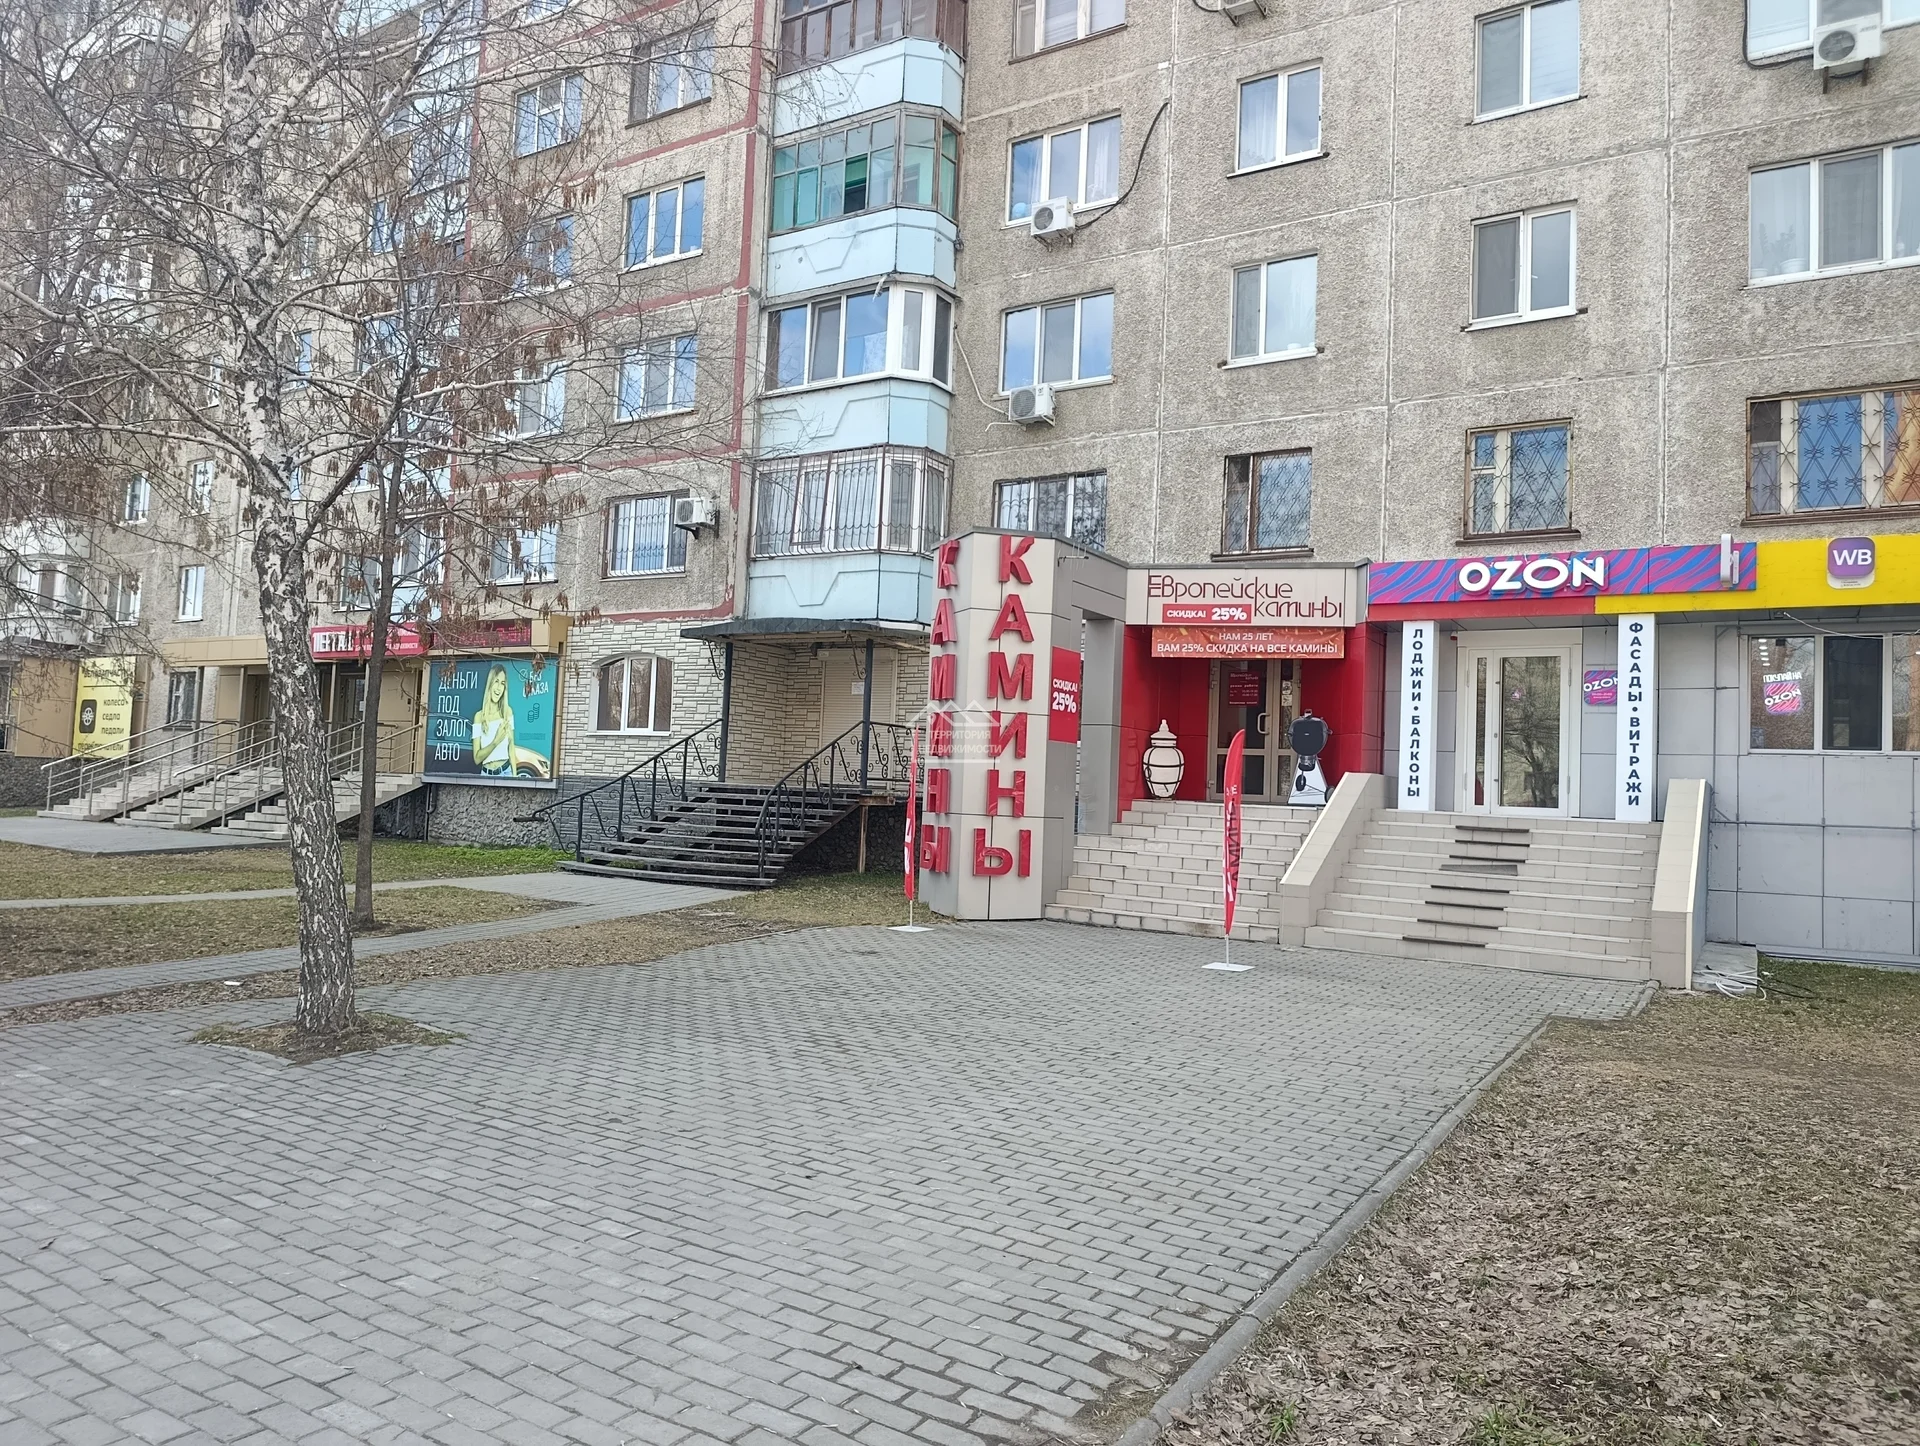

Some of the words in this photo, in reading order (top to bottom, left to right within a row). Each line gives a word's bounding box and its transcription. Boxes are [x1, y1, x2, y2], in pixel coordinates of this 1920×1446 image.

[1832, 549, 1873, 566] WB
[1458, 556, 1605, 592] OZON
[1148, 575, 1293, 603] Европейские
[1166, 609, 1207, 619] СКИДКА!
[1211, 607, 1248, 621] 25%
[1254, 595, 1342, 619] камины
[1219, 633, 1241, 641] НАМ
[1242, 633, 1254, 641] 25
[1255, 633, 1274, 641] ЛЕТ
[1157, 643, 1180, 652] ВАМ
[1181, 643, 1204, 652] 25%
[1205, 643, 1248, 654] СКИДКА
[1249, 644, 1265, 653] НА
[1267, 644, 1287, 653] ВСЕ
[1289, 644, 1338, 653] КАМИНЫ
[1410, 628, 1424, 702] ЛОДЖИИ
[1627, 622, 1643, 702] ФАСАДЫ
[522, 681, 549, 698] ОКАЗА
[1052, 678, 1078, 692] СКИДКА!
[437, 695, 460, 715] ПОД
[972, 534, 1035, 878] КАМИНЫ
[1052, 692, 1077, 714] 25%
[1764, 688, 1802, 706] OZON
[436, 719, 468, 737] ЗАЛОГ
[434, 743, 461, 761] АВТО
[1407, 715, 1421, 797] БАЛКОНЫ
[1626, 716, 1642, 806] ВИТРАЖИ
